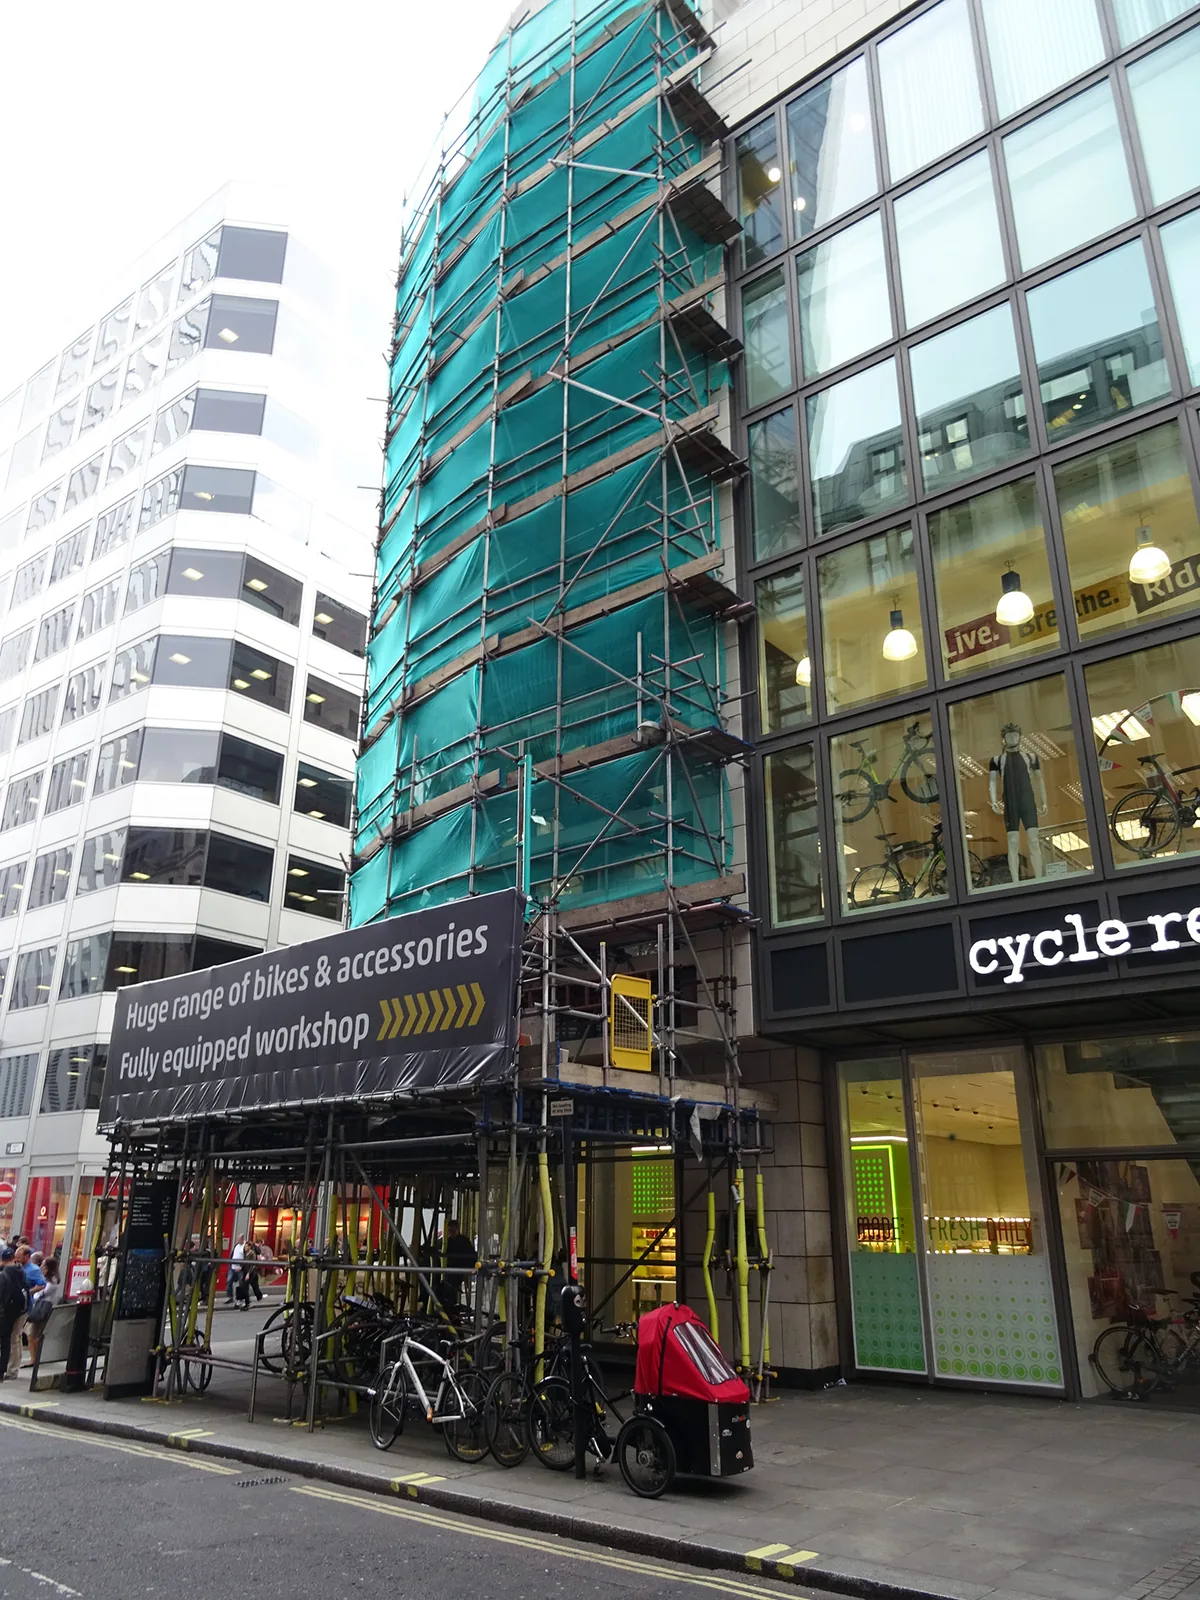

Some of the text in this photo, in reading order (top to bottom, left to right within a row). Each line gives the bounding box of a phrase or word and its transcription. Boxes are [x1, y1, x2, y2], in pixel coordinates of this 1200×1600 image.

[945, 561, 1200, 657] Live. Brethe. Rid
[126, 922, 488, 1032] Huge range of bikes & accessories
[969, 914, 1131, 984] cycle
[119, 1010, 370, 1082] Fully equipped workshop
[857, 1217, 900, 1241] MADE
[927, 1217, 980, 1242] FRESH
[986, 1217, 1032, 1242] DAILY
